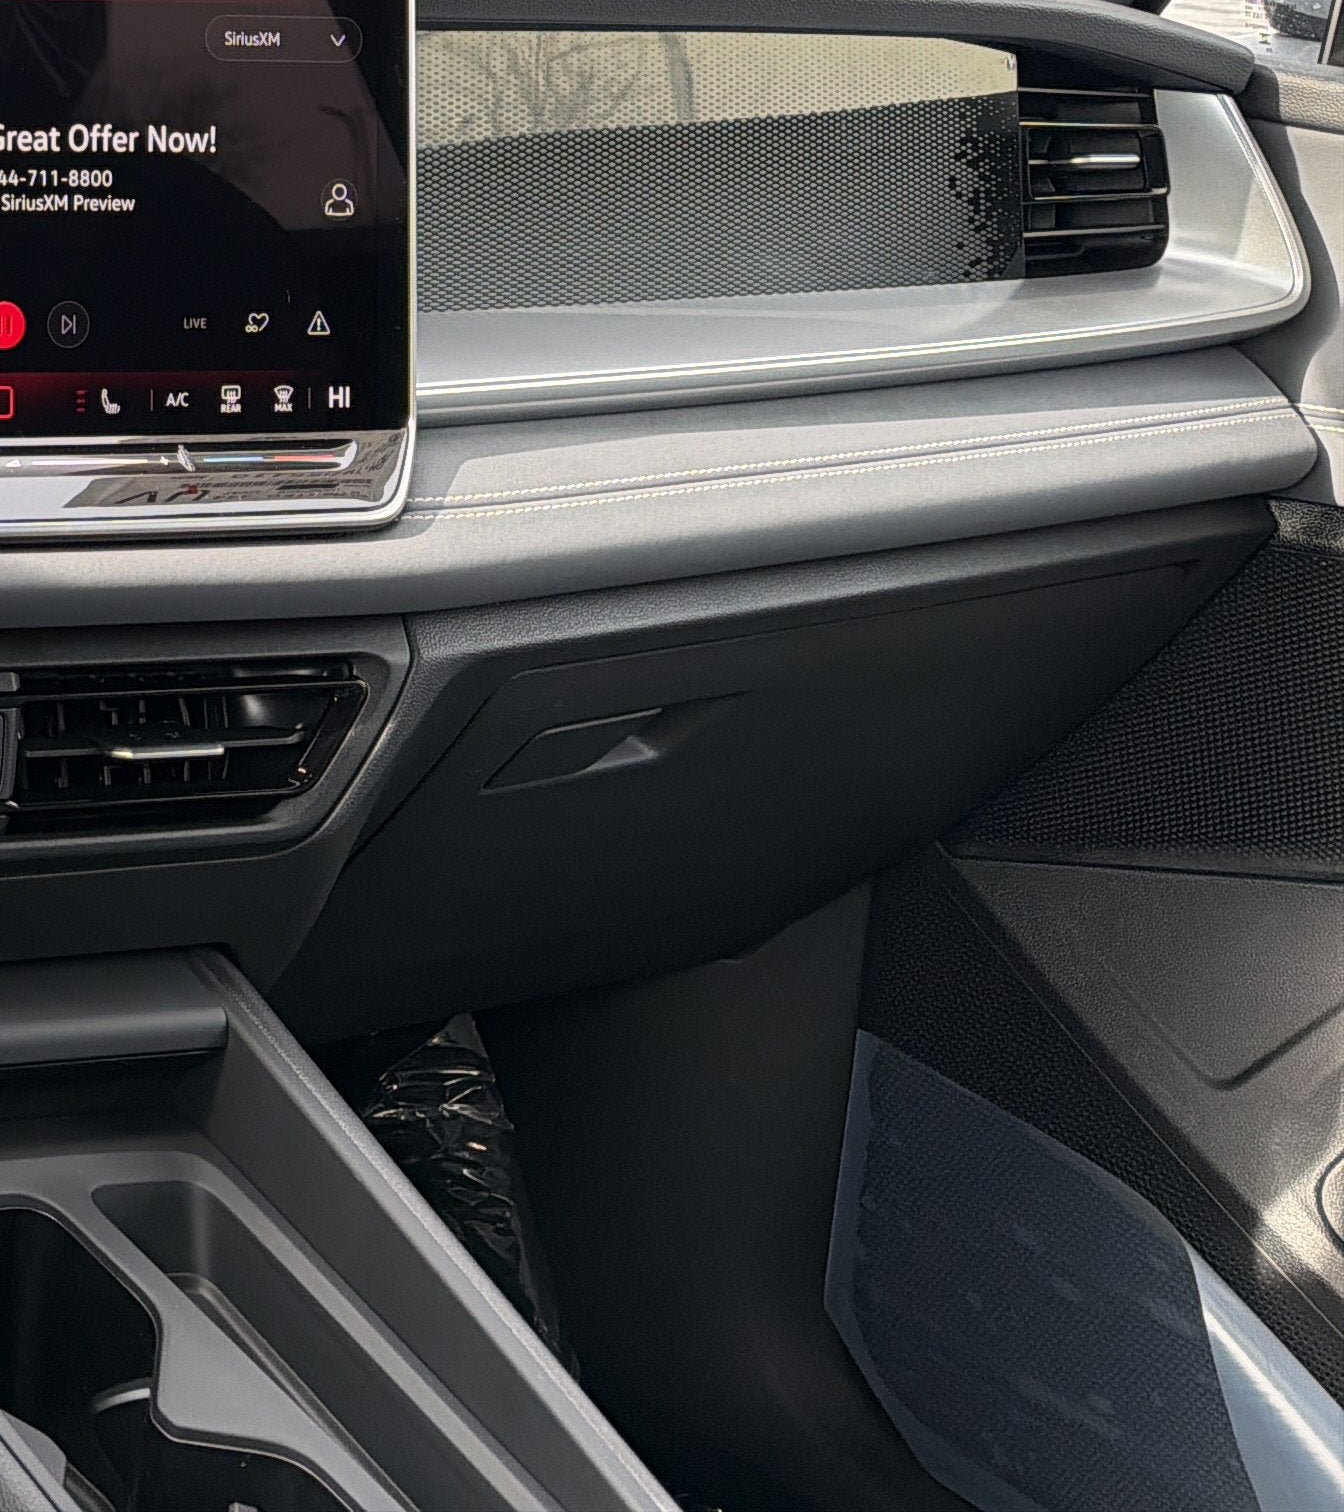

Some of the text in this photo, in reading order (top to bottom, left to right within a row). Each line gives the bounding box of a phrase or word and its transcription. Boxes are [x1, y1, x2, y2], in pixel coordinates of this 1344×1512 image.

[224, 29, 281, 48] SiriusXM
[67, 122, 139, 154] Offer
[145, 124, 219, 155] Now!
[0, 193, 69, 213] SiriusXM
[74, 193, 136, 213] Preview
[183, 317, 207, 330] LIVE
[165, 385, 351, 414] A/C REAR MAX HI
